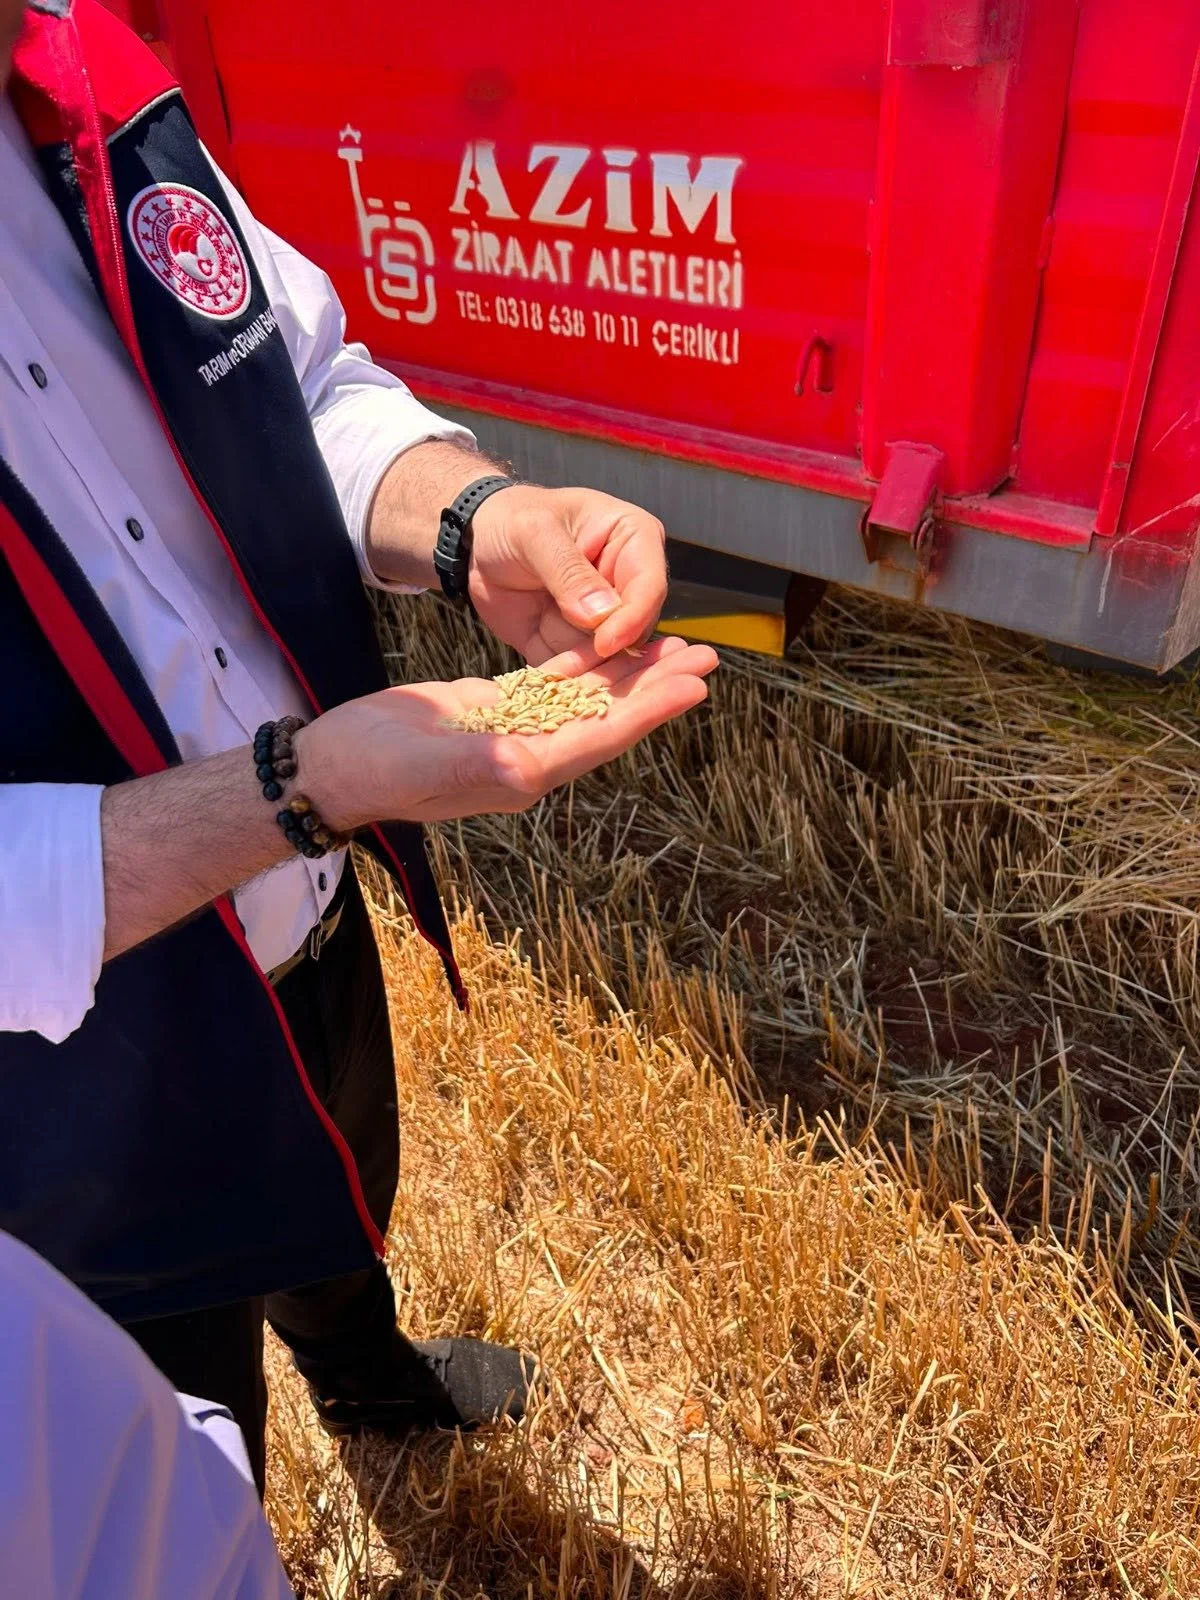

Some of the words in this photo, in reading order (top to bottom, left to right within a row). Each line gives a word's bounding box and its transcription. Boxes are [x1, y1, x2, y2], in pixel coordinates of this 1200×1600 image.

[449, 139, 743, 243] AZİM
[451, 220, 574, 284] ZİRAAT
[586, 249, 743, 309] ALETLERİ
[198, 351, 233, 387] TARIM
[232, 319, 269, 359] ORMAN
[456, 290, 491, 322] TEL:
[495, 296, 543, 331] 0318
[548, 305, 586, 338] 638
